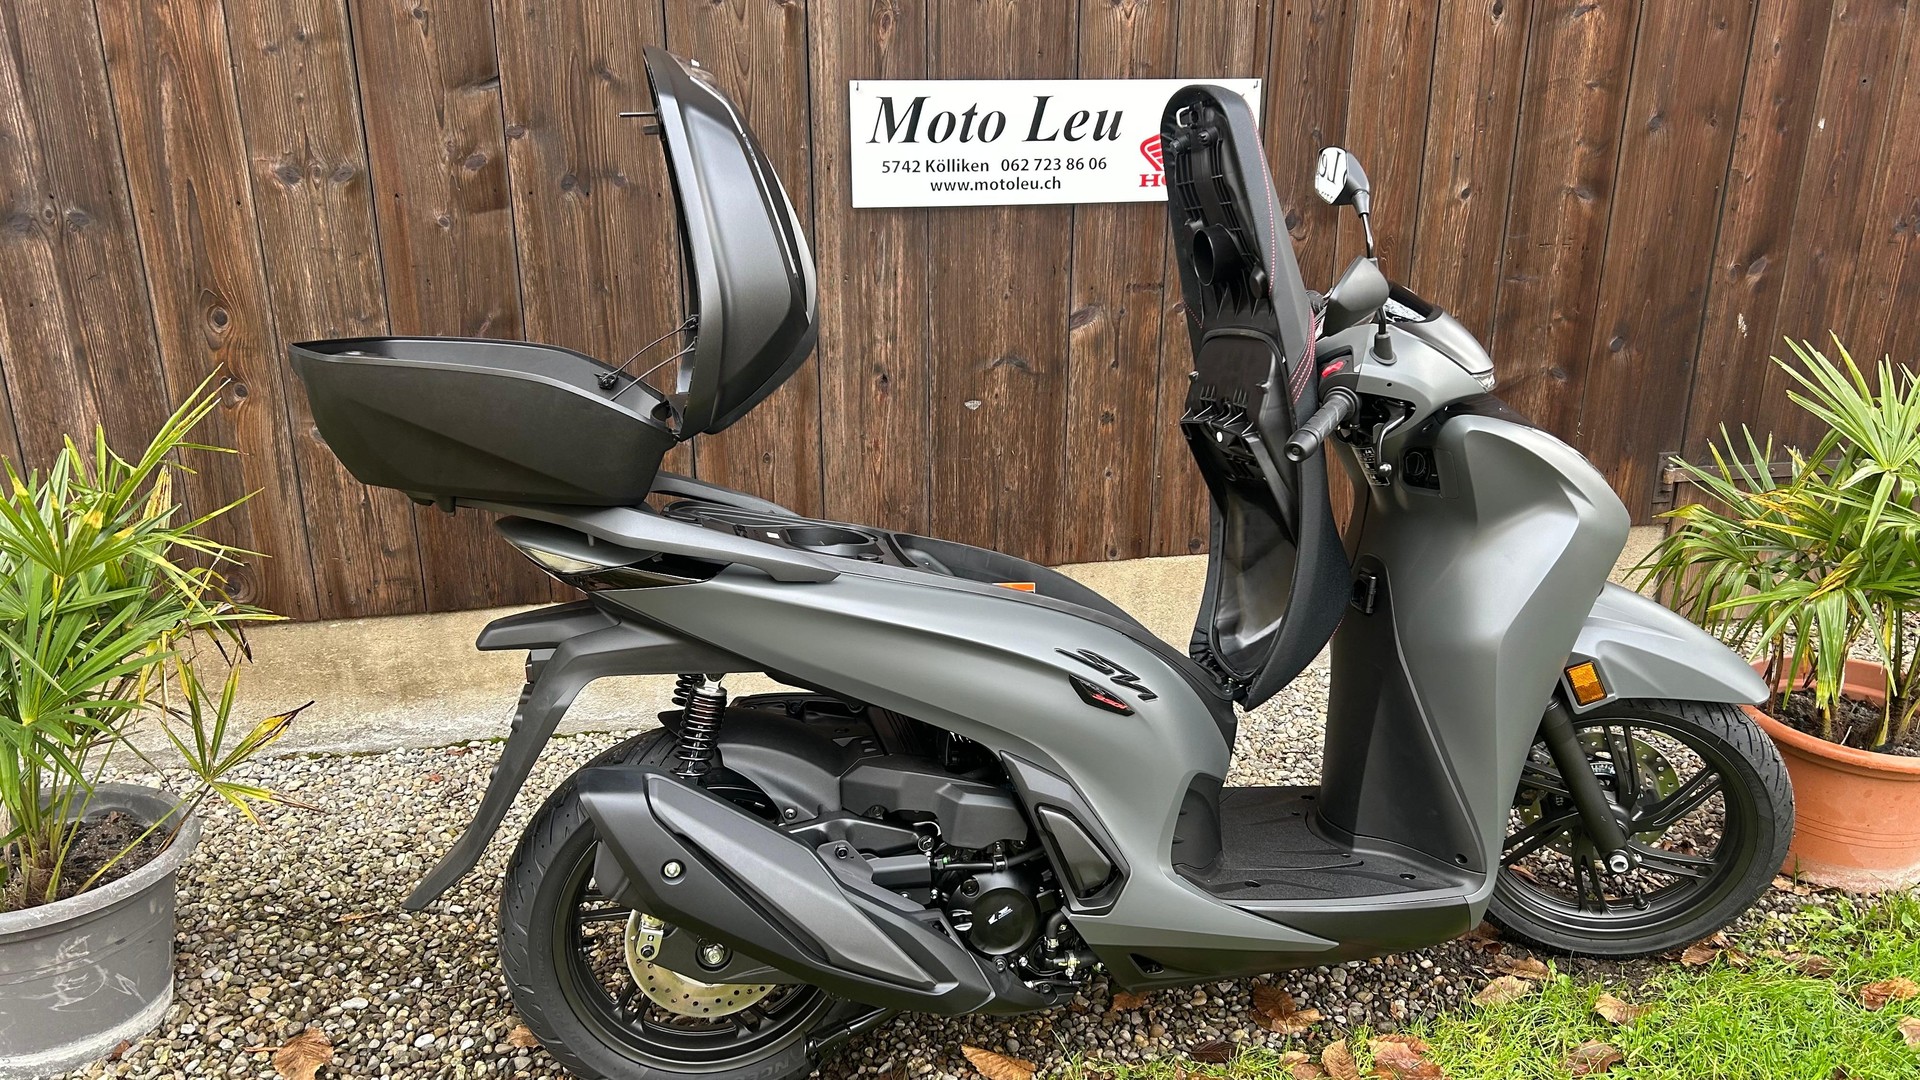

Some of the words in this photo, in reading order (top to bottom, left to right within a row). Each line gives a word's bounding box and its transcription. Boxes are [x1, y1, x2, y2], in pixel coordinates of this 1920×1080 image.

[866, 96, 1007, 143] Moto
[1022, 95, 1123, 142] Leu
[881, 159, 921, 173] 5742
[925, 157, 989, 173] Kölliken
[1001, 158, 1029, 172] 062
[1034, 157, 1062, 171] 723
[1066, 157, 1085, 171] 86
[1088, 156, 1107, 170] 06
[930, 175, 1061, 192] www.motoleu.ch
